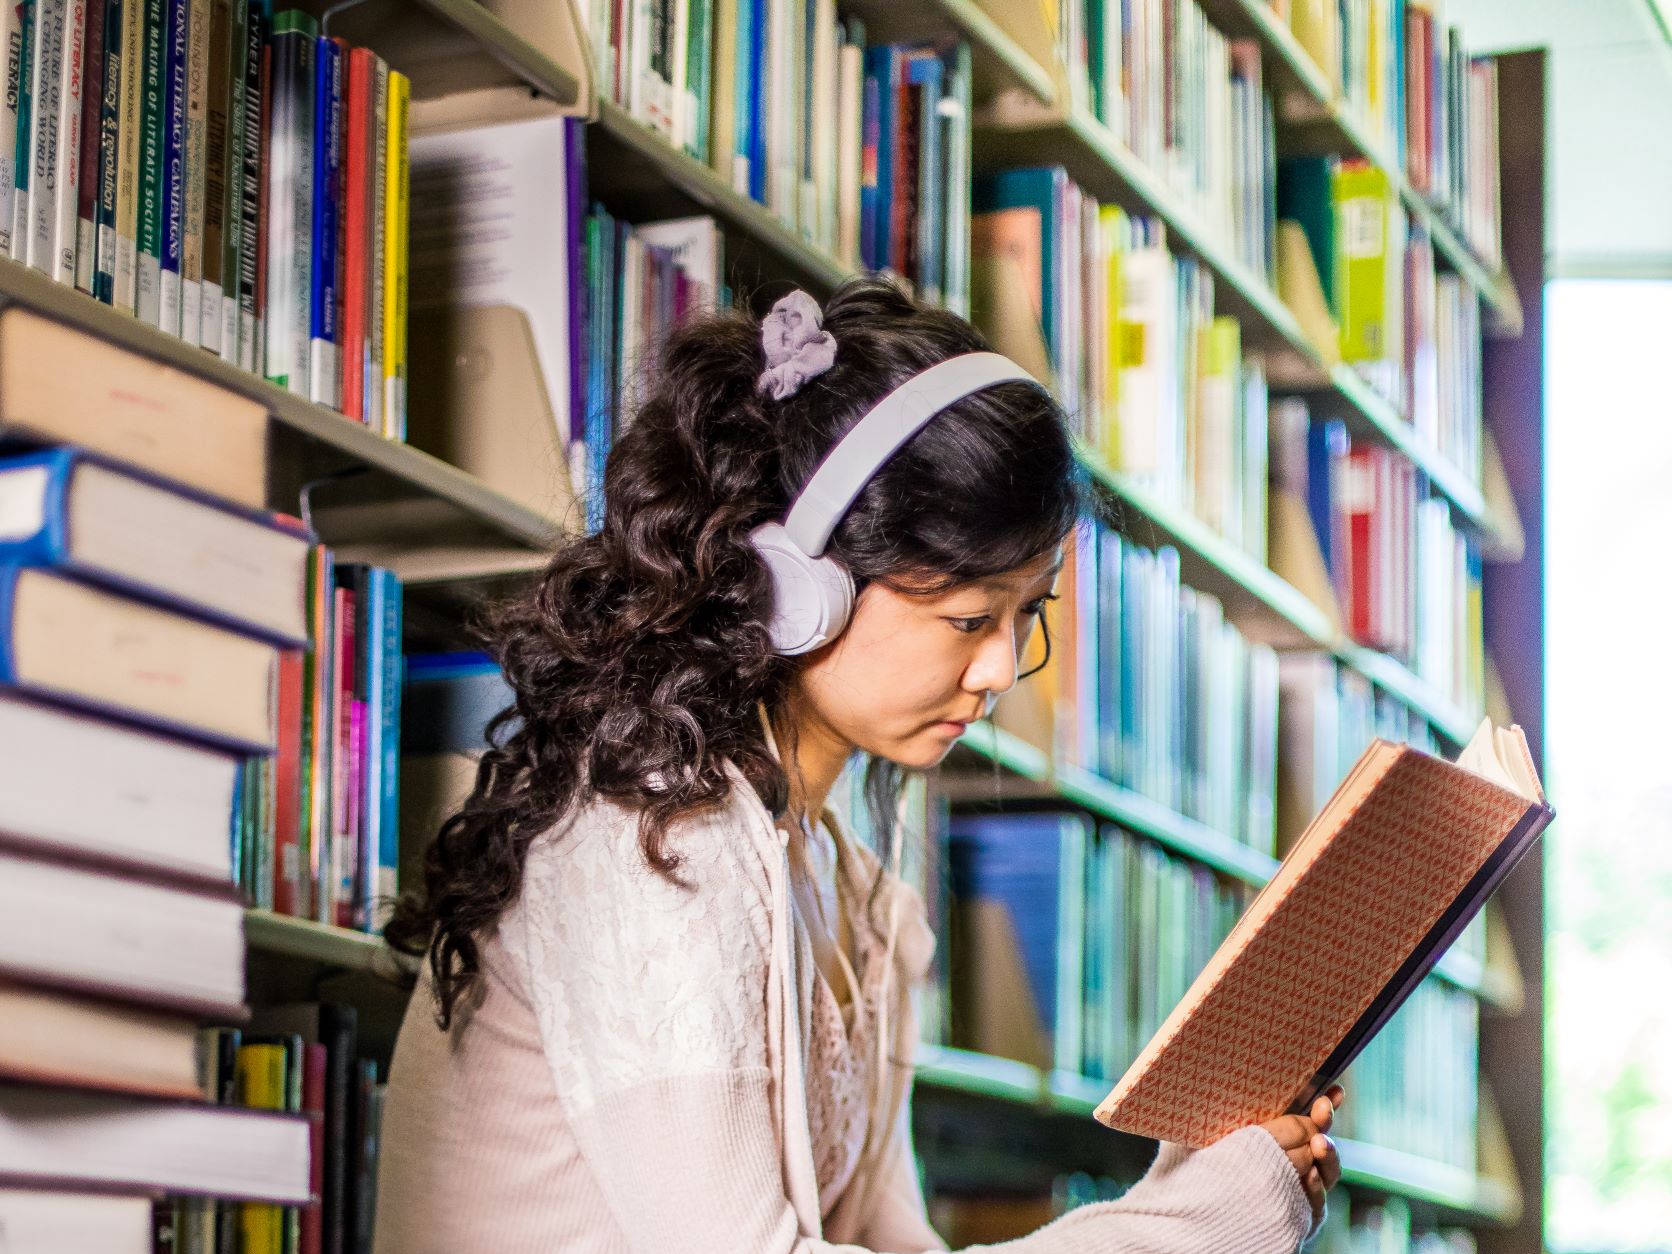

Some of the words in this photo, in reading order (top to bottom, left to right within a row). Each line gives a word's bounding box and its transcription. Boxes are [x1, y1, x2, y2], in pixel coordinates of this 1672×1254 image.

[50, 14, 63, 83] FUTURE
[74, 4, 83, 26] OF
[175, 0, 186, 56] IONAL
[248, 13, 260, 76] TYNER
[6, 31, 21, 115] LITERACY
[40, 21, 51, 111] CHANGING
[71, 28, 81, 101] LITERACY
[105, 51, 119, 111] literacy
[148, 26, 160, 87] MAKING
[191, 10, 203, 95] ROBINSON
[49, 86, 58, 111] OF
[106, 116, 118, 130] &
[148, 91, 158, 111] OF
[171, 64, 184, 149] LITERACY
[36, 115, 47, 178] WORLD
[46, 114, 57, 202] LITERACY
[103, 131, 116, 211] revolution
[144, 114, 157, 184] LITERATE
[168, 158, 181, 259] CAMPAIGNS
